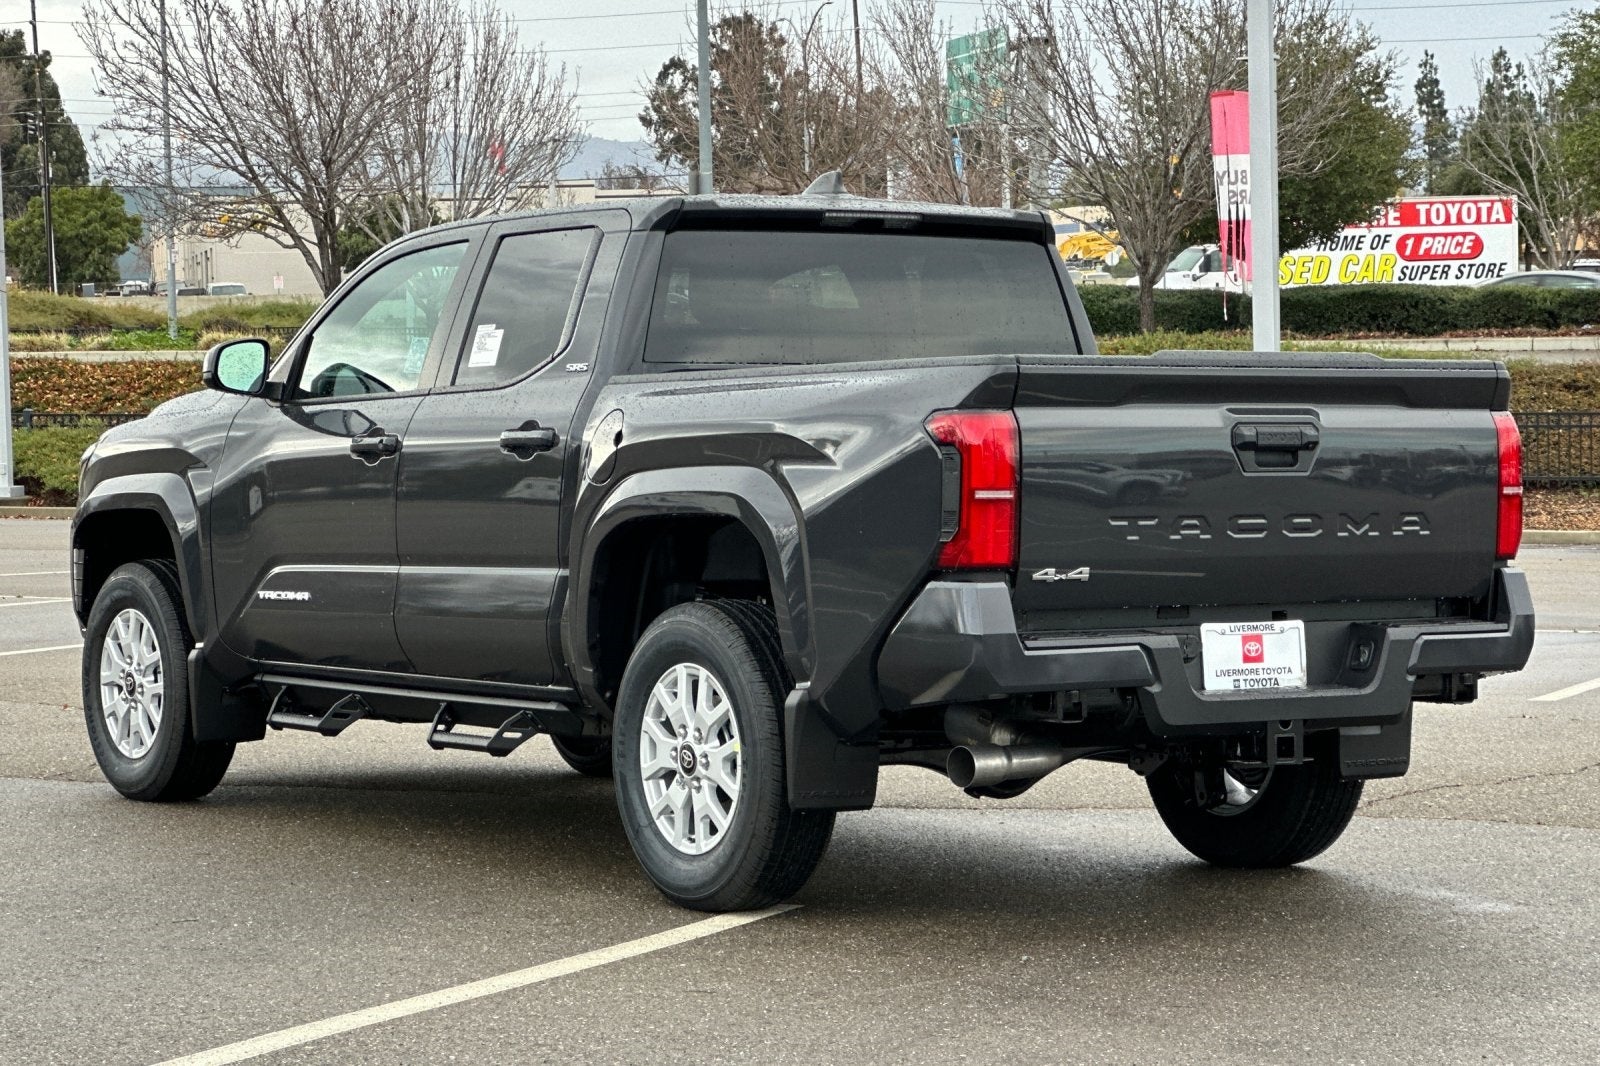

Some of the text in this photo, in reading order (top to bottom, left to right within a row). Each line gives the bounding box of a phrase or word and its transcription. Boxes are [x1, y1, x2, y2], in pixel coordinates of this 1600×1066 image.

[1416, 202, 1506, 225] TOYOTA
[1317, 234, 1475, 256] HOME OF 1 PRICE
[1339, 254, 1397, 284] CAR
[1398, 262, 1508, 281] SUPER STORE
[1108, 512, 1431, 541] TACOMA
[257, 590, 311, 601] TACOMA
[1229, 623, 1276, 633] LIVERMORE
[1215, 666, 1293, 678] LIVERMORE TOYOTA
[1242, 677, 1280, 688] TOYOTA
